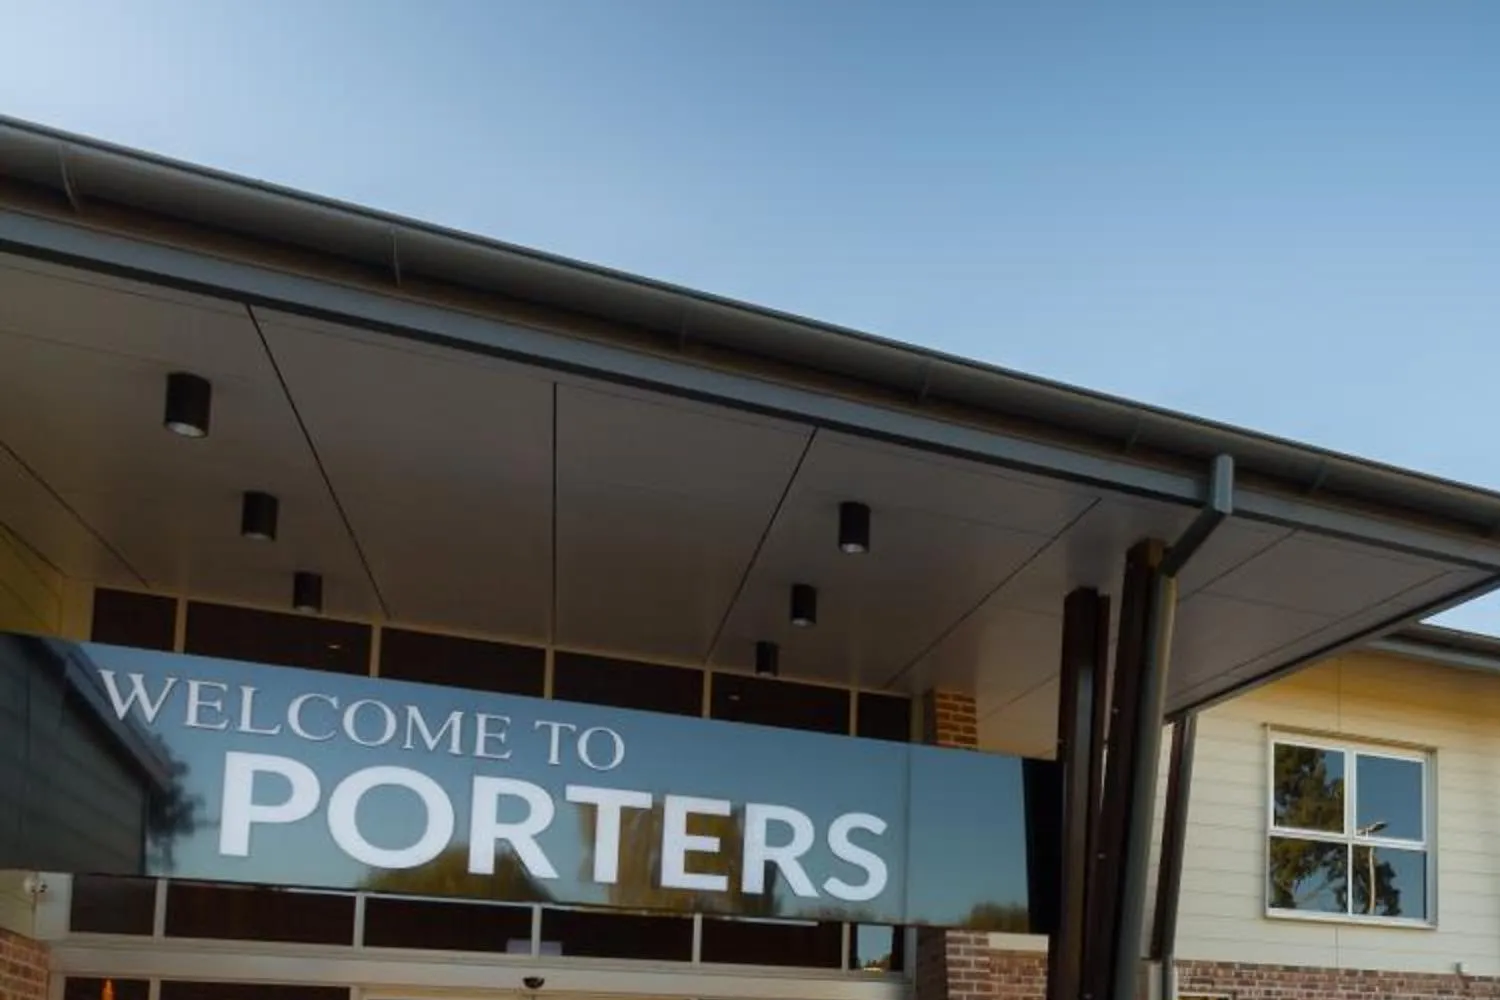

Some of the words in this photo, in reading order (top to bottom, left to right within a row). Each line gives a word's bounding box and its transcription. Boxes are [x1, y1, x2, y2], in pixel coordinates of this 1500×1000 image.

[98, 668, 511, 761] WELCOME
[534, 719, 625, 771] TO
[218, 750, 889, 901] PORTERS
